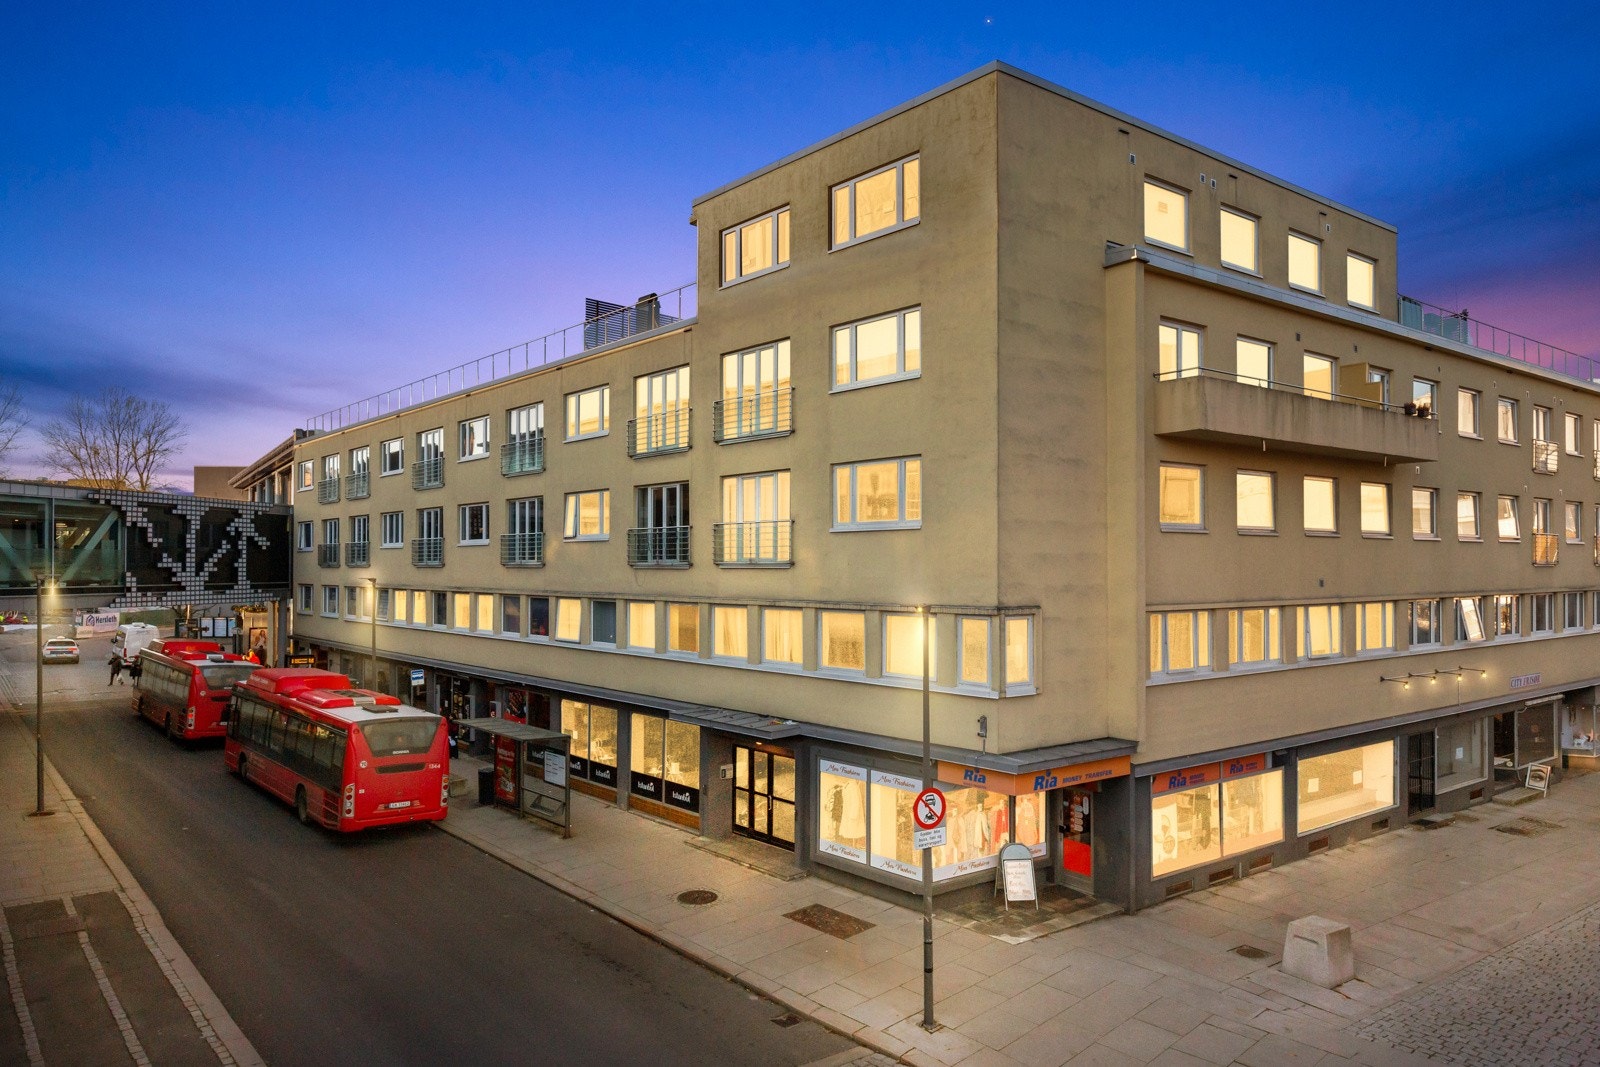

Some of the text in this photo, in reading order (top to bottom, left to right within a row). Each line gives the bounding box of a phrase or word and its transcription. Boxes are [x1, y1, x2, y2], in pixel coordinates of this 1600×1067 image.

[840, 766, 860, 776] Fashion
[1229, 760, 1244, 774] Ria
[892, 777, 915, 789] Fashion
[963, 767, 987, 784] Ria
[1033, 769, 1113, 790] Ria MONEY TRANSFER
[1168, 769, 1187, 789] Ria
